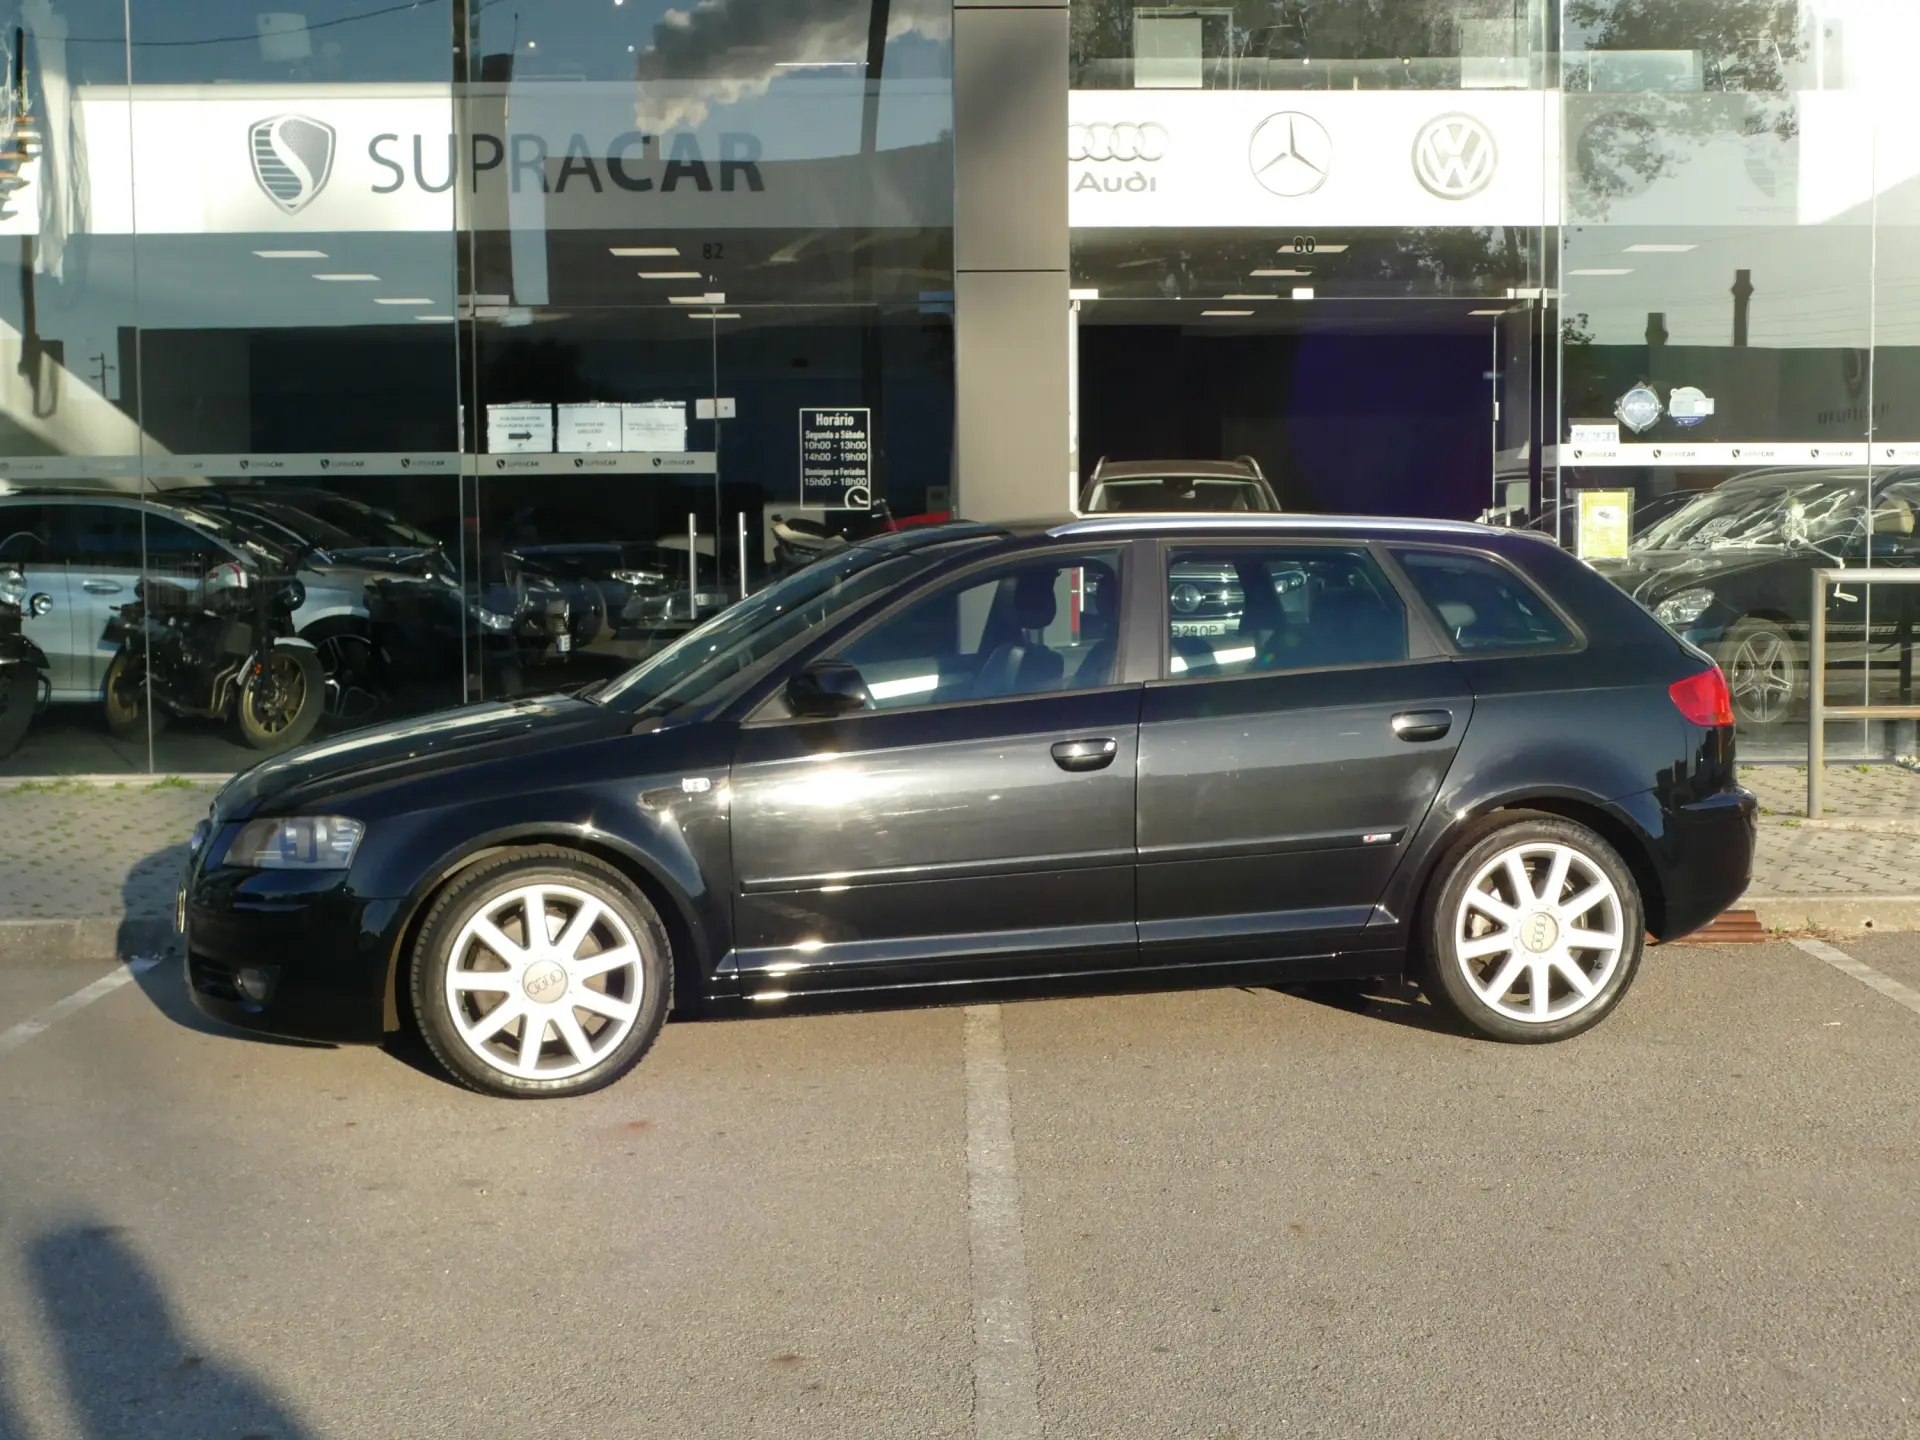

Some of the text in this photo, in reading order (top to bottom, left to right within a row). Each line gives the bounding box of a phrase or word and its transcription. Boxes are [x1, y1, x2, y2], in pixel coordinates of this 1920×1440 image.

[368, 132, 766, 194] SUPRACAR
[1074, 171, 1157, 192] Audi
[1293, 236, 1316, 254] 80
[702, 243, 725, 259] 82
[815, 413, 855, 426] Horário
[805, 430, 834, 440] Segunda
[840, 430, 865, 439] Sábado
[804, 441, 831, 450] 10h00
[840, 441, 867, 450] 13h00
[804, 452, 831, 461] 14h00
[840, 452, 867, 461] 19h00
[840, 468, 866, 476] Feriados
[804, 478, 831, 486] 15h00
[840, 478, 867, 486] 18h00
